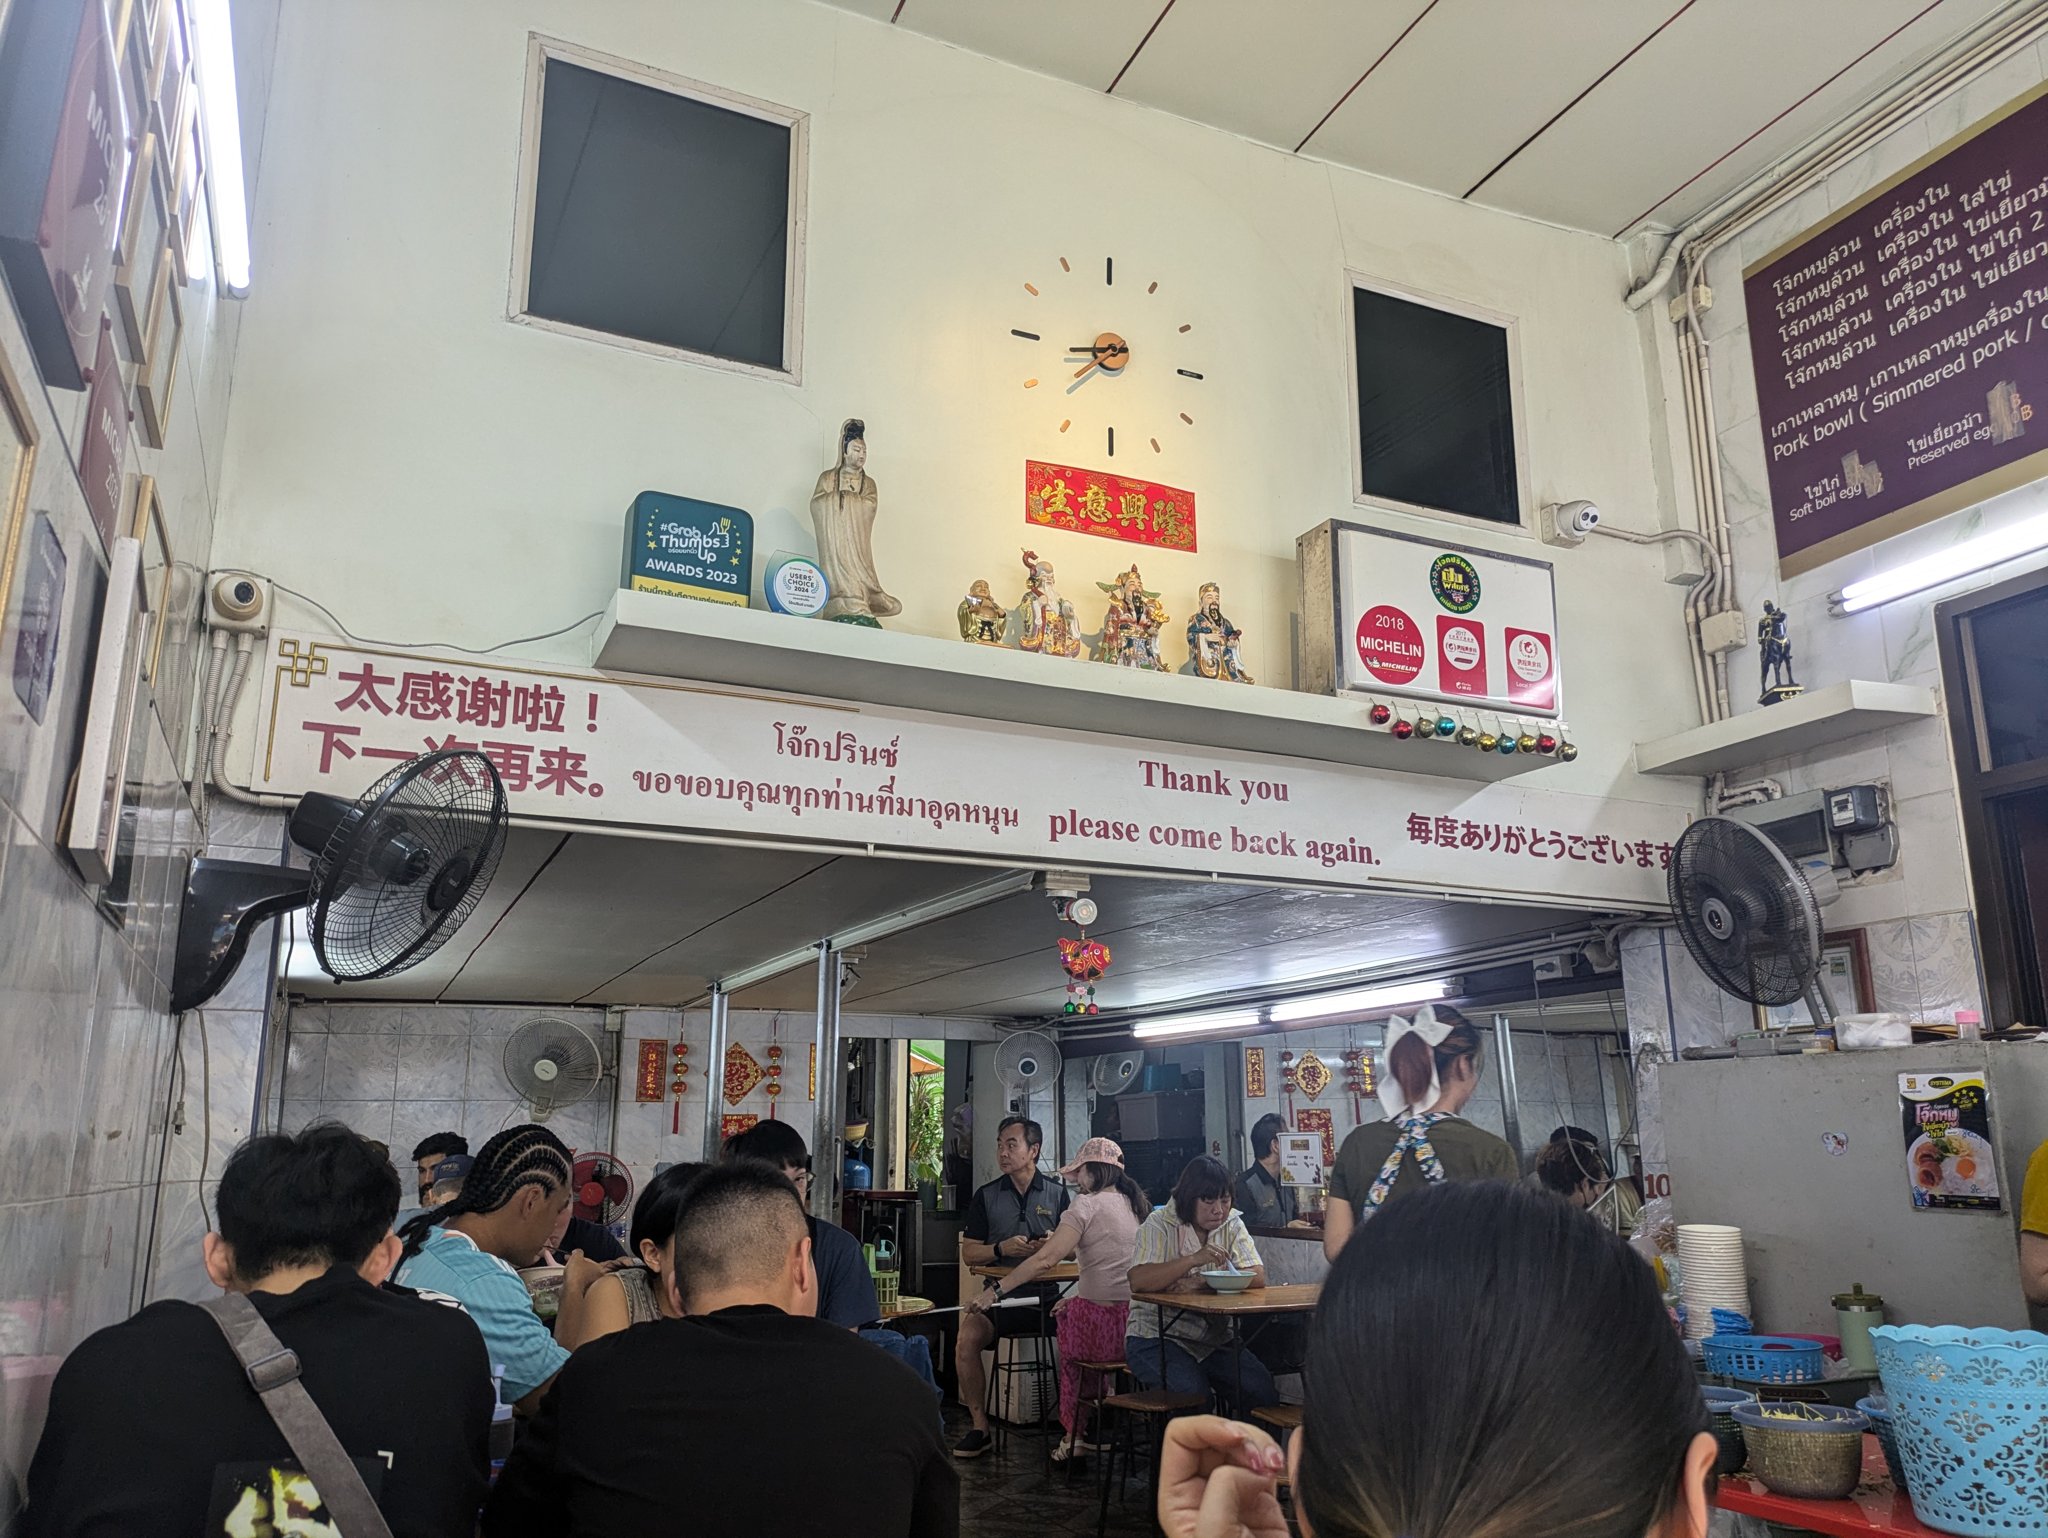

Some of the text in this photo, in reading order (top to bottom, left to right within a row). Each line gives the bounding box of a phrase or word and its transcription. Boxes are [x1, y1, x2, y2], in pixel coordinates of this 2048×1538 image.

[1772, 183, 1950, 297] โจ๊กหมูล้วน เครื่องใน
[1775, 169, 2013, 320] โจ๊กหมูล้วน เครื่องใน ใส่ไข่
[1778, 284, 1870, 343] โจ๊กหมูล้วน
[1881, 233, 1958, 287] เครื่องใน
[1781, 210, 2045, 366] โจ๊กหมูล้วน เครื่องใน ไข่ไก่ 2
[1784, 333, 1877, 390] โจ๊กหมูล้วน
[1889, 284, 1967, 337] เครื่องใน
[1771, 384, 1859, 439] เกาเหลาหมู
[1773, 432, 1810, 462] Pork
[1813, 408, 1854, 442] bowl
[1872, 352, 1966, 413] Simmered
[1972, 329, 2019, 369] pork
[1906, 412, 1983, 454] ไข่เยี่ยวม้า
[1907, 432, 1970, 470] Preserved
[1040, 478, 1184, 536] 生意興隆
[1789, 482, 1862, 522] Soft boil egg
[1803, 474, 1840, 500] ไข่ไก่
[660, 522, 701, 540] #Grab
[660, 534, 720, 549] Thumbs
[645, 558, 738, 585] AWARDS 2023
[698, 549, 717, 564] Up
[787, 578, 815, 588] CHOICE
[1375, 614, 1404, 631] 2018
[1360, 635, 1422, 658] MICHELIN
[1381, 661, 1418, 672] MICHELIN
[334, 662, 599, 733] 太感谢啦！
[772, 721, 900, 768] โจ๊กปรินซ์
[632, 769, 1019, 835] ขอขอบคุณทุกท่านที่มาอุดหนุน
[1138, 760, 1289, 805] Thank you
[1048, 809, 1381, 868] please come back again.
[1406, 812, 1676, 871] 毎度ありがとうございます
[1915, 1102, 1959, 1128] โจ๊กหมู
[1644, 1173, 1671, 1199] 10
